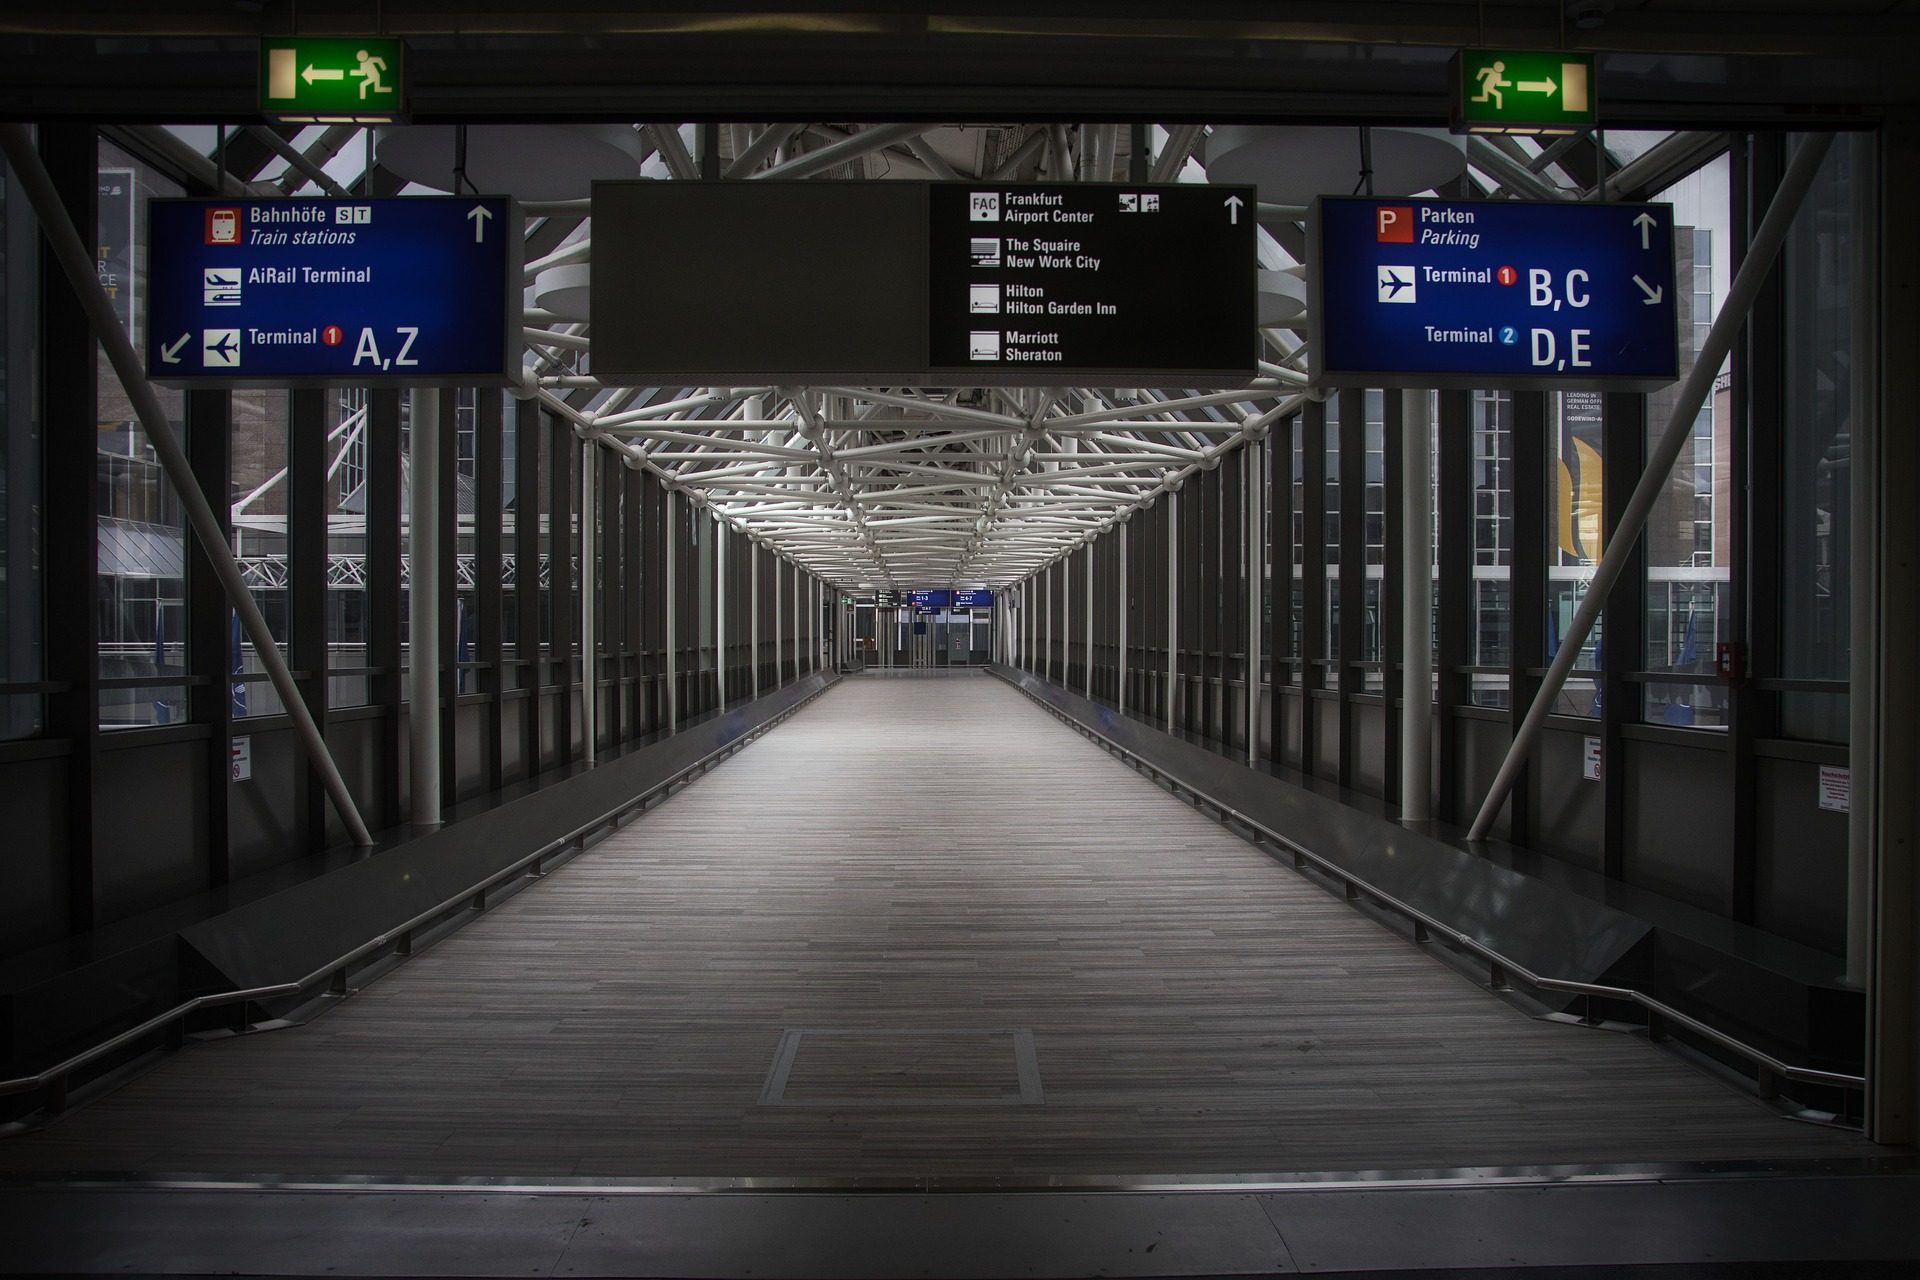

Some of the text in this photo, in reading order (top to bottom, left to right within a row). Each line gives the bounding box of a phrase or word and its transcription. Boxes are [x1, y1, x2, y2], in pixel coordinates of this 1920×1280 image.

[973, 198, 996, 210] FAC
[1005, 193, 1063, 206] Frankfurt
[250, 206, 326, 223] Bahnhöfe
[1004, 210, 1094, 225] Airport Center
[1379, 210, 1397, 234] P
[1421, 207, 1475, 224] Parken
[249, 229, 356, 245] Train stations
[1420, 229, 1480, 249] Parking
[1006, 238, 1080, 254] The Squaire
[1006, 255, 1101, 272] New Work City
[249, 267, 371, 284] AiRail Terminal
[1006, 284, 1044, 297] Hilton
[1422, 266, 1491, 284] Terminal
[1529, 267, 1590, 312] B,C
[1006, 302, 1117, 315] Hilton Garden Inn
[1006, 331, 1059, 344] Marriott
[249, 328, 317, 345] Terminal
[352, 326, 420, 372] A,Z
[1006, 349, 1062, 362] Sheraton
[1424, 326, 1493, 343] Terminal
[1530, 328, 1592, 372] D,E
